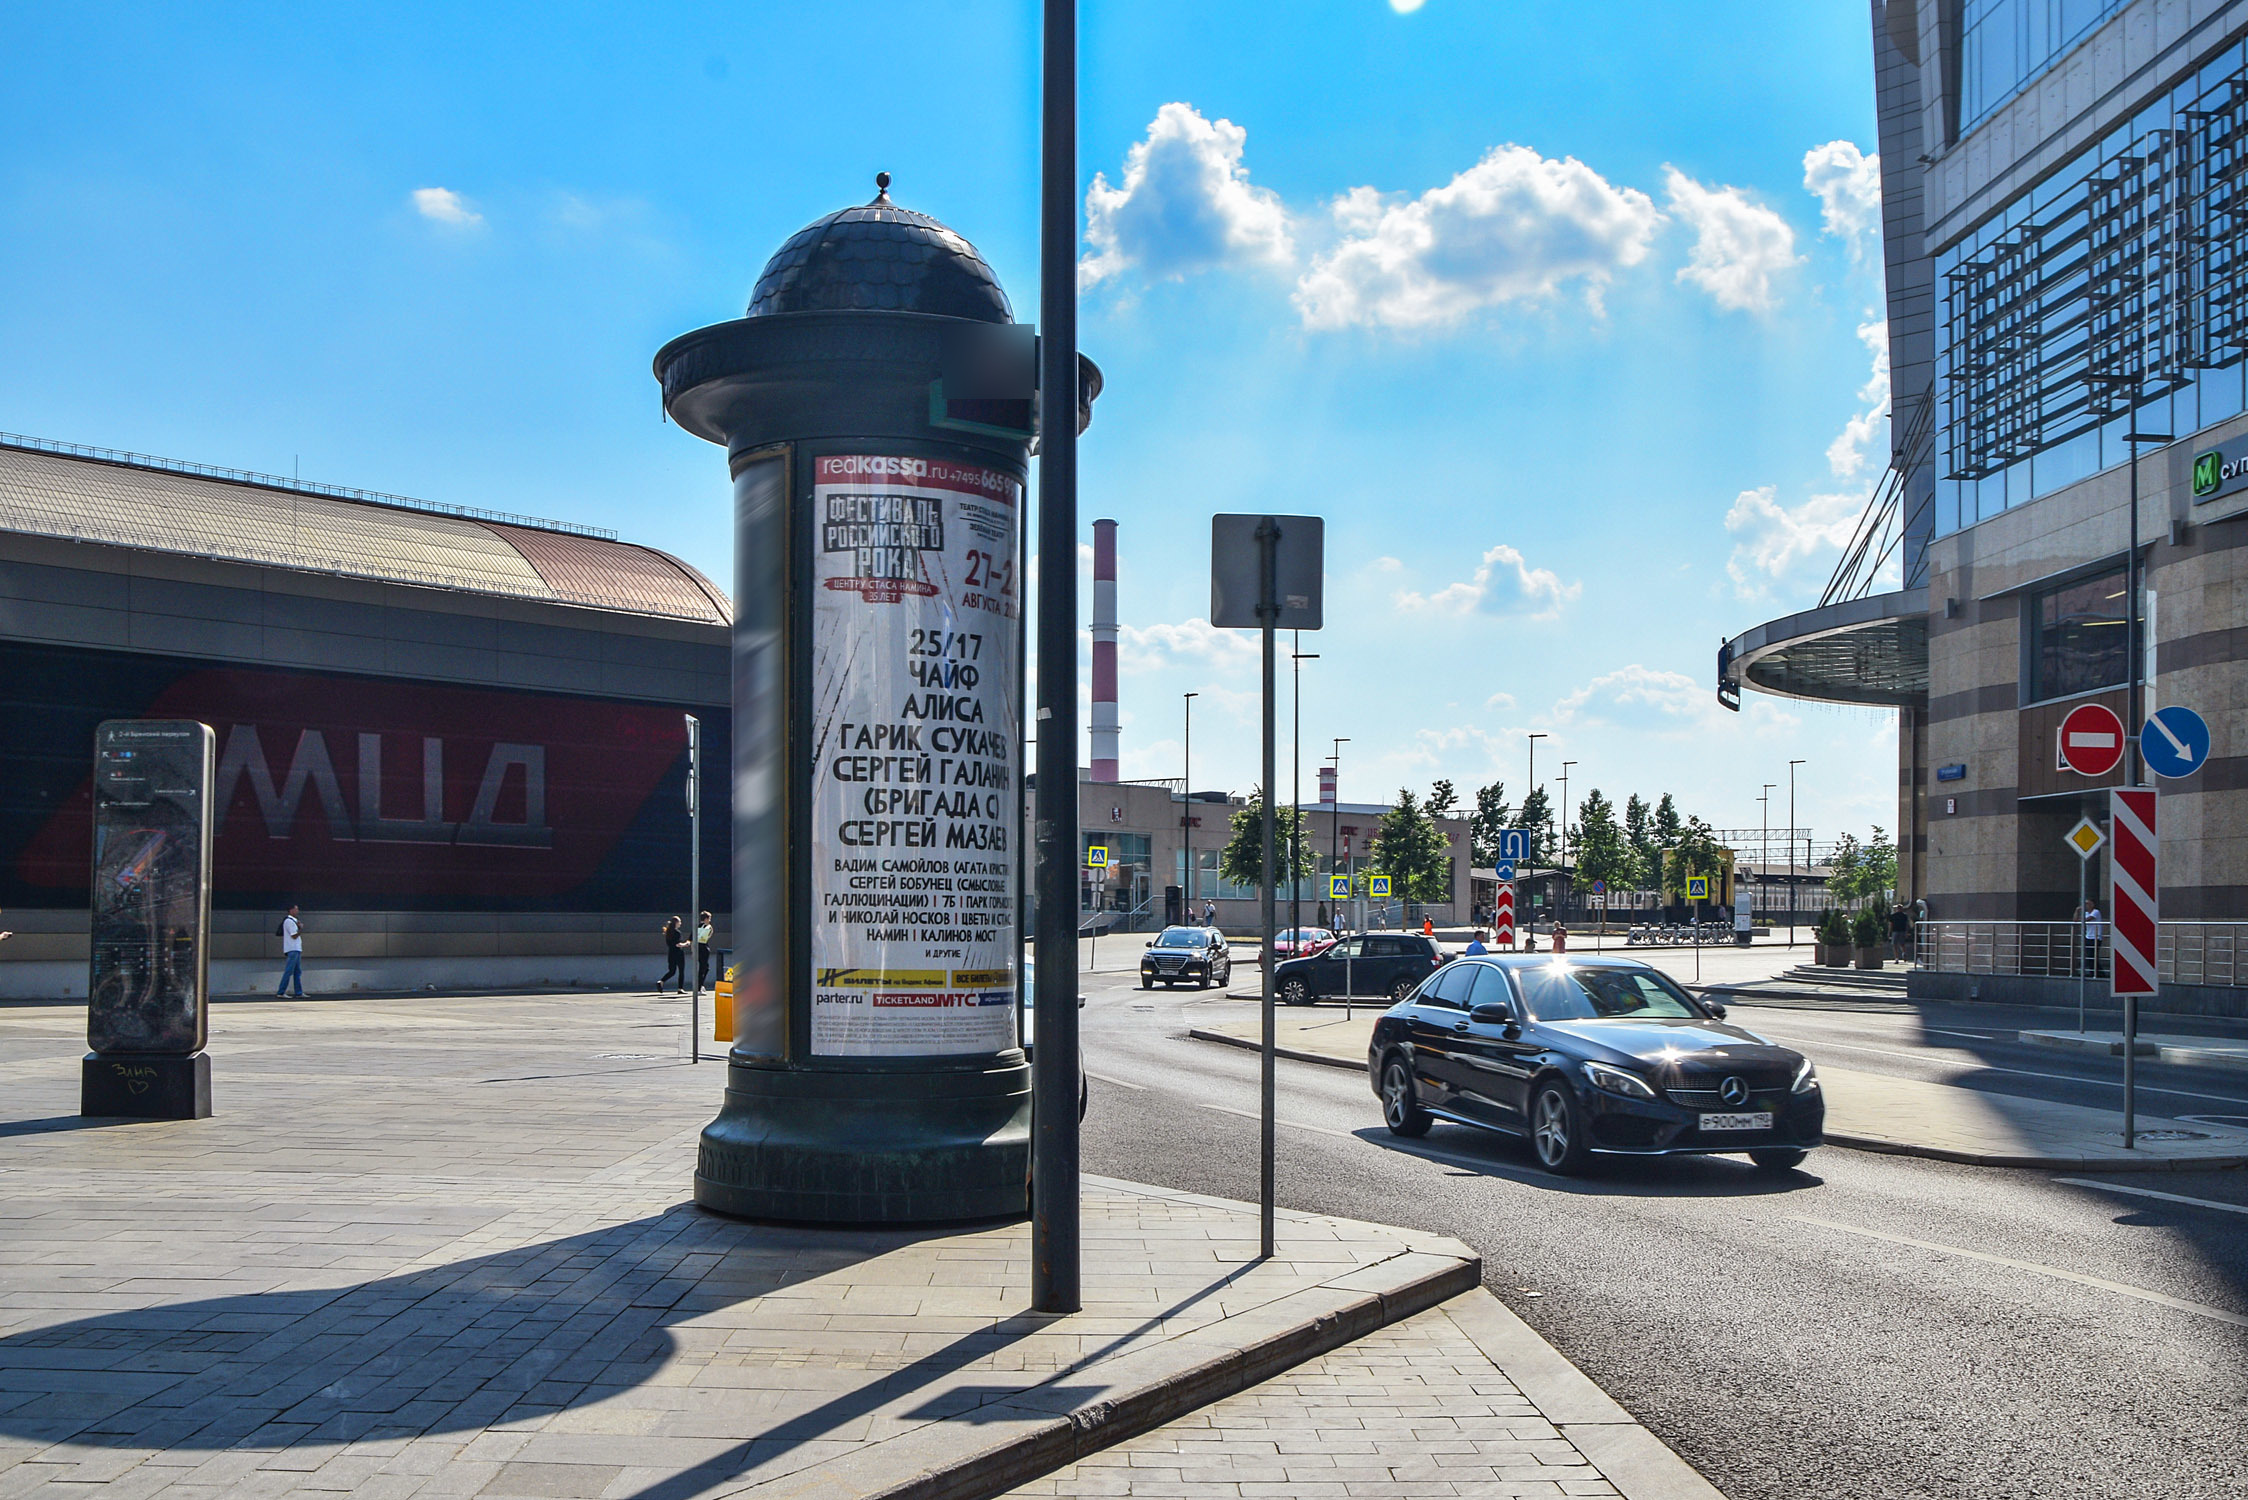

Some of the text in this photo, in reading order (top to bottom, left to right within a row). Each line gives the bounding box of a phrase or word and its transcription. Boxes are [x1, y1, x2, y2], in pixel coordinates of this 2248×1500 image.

[830, 497, 939, 526] ФЕСТИВАЛЬ
[828, 521, 940, 549] РОССИЙСКОГО
[858, 547, 916, 578] РОКА
[965, 549, 1012, 596] 27-2
[834, 579, 932, 594] ЦЕНТРУ СТАСА НАМИНА
[879, 592, 897, 602] ЛЕТ
[962, 592, 1001, 615] АВГУСТА
[909, 629, 983, 660] 25/17
[909, 659, 979, 690] ЧАЙФ
[901, 693, 984, 724] АЛИСА
[840, 723, 1007, 760] ГАРИК СУКАЧЕВ
[833, 753, 1009, 791] СЕРГЕЙ ГАЛАНИН
[213, 724, 553, 849] МЦД
[864, 787, 999, 820] (БРИГАДА С)
[838, 817, 1007, 850] СЕРГЕЙ МАЗАЕВ
[834, 858, 877, 872] ВАДИМ
[881, 858, 949, 873] САМОЙЛОВ
[954, 861, 987, 874] (АГАТА
[849, 875, 896, 889] СЕРГЕЙ
[900, 877, 952, 891] БОБУНЕЦ
[824, 893, 929, 908] ГАЛЛЮЦИНАЦИИ)
[966, 896, 988, 908] ПАРК
[828, 911, 837, 923] И
[841, 909, 898, 924] НИКОЛАЙ
[902, 912, 950, 925] НОСКОВ
[961, 912, 991, 926] ЦВЕТЫ
[867, 929, 997, 942] НАМИН КАЛИНОВ МОСТ
[933, 949, 961, 958] ДРУГИЕ
[816, 993, 863, 1005] parter.ru
[876, 996, 935, 1005] TICKETLAND
